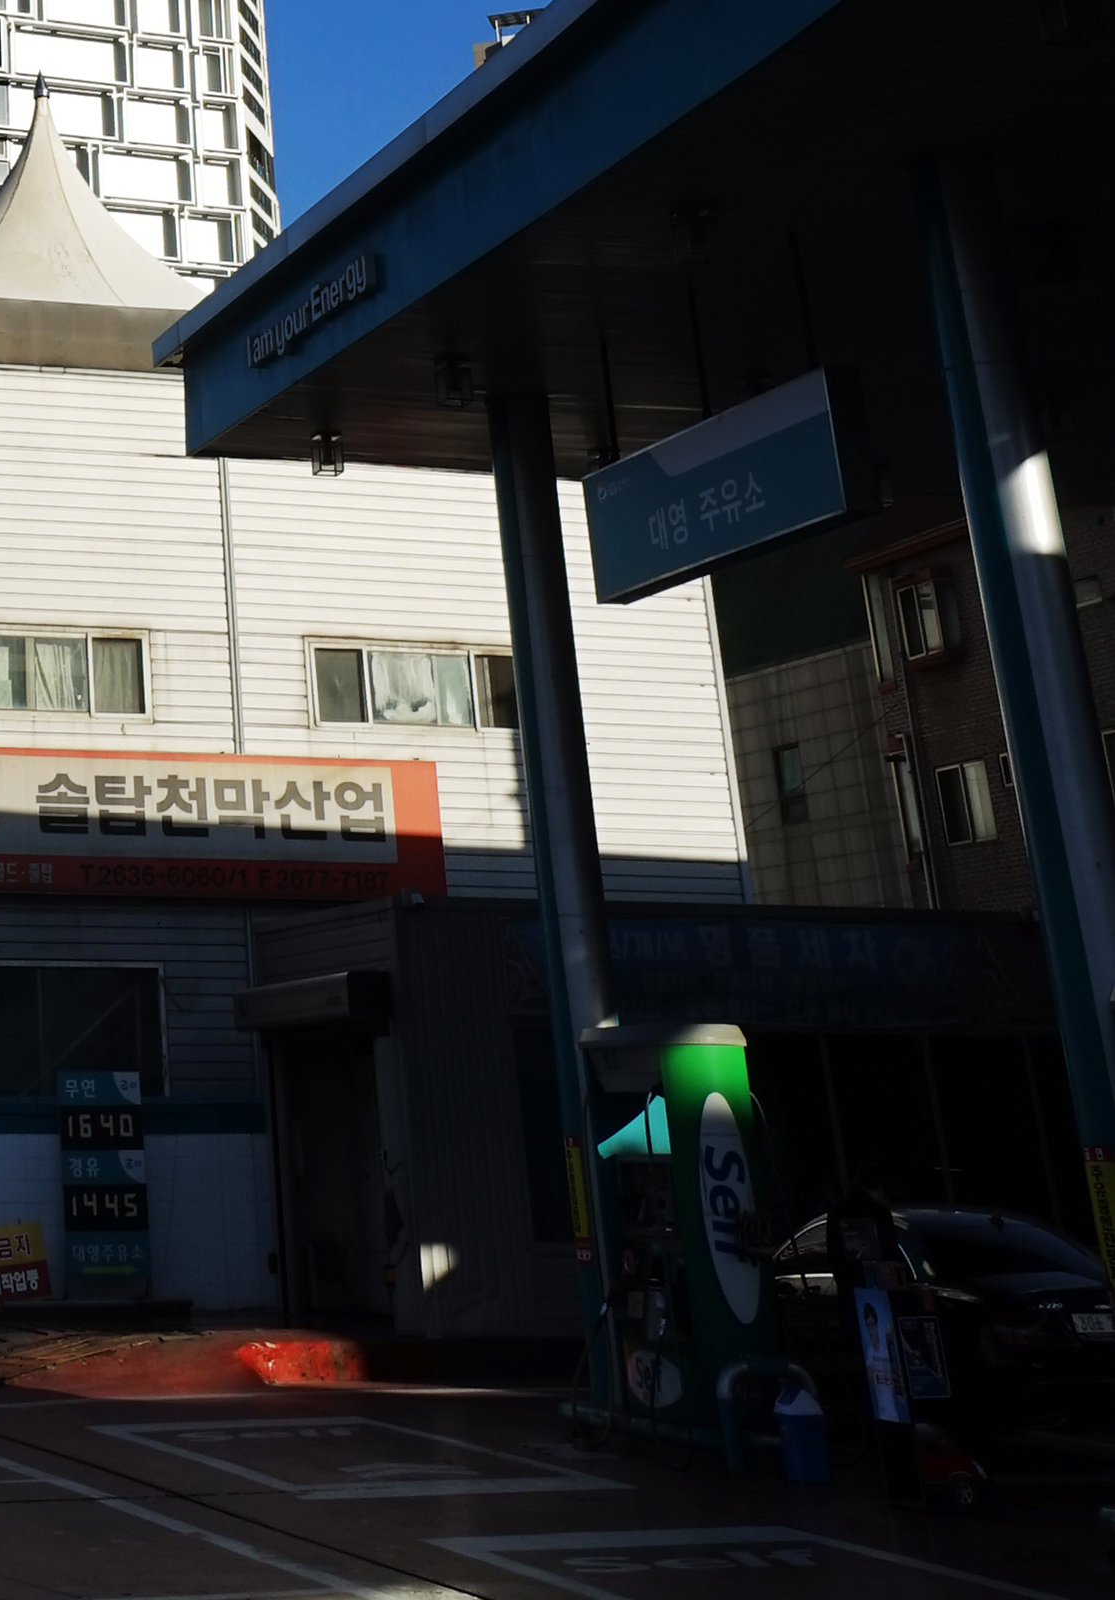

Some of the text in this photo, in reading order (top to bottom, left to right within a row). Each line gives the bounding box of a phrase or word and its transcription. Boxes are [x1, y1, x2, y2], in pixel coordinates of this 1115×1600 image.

[252, 328, 274, 365] am
[274, 300, 310, 356] your
[309, 254, 368, 322] Energy
[647, 472, 767, 550] 대영 주유소
[35, 773, 387, 844] 솔탑천막산업
[64, 1078, 96, 1099] 무연
[66, 1113, 135, 1140] 1640
[68, 1157, 101, 1179] 경유
[71, 1191, 139, 1218] 1445
[71, 1243, 145, 1264] 대영주유소
